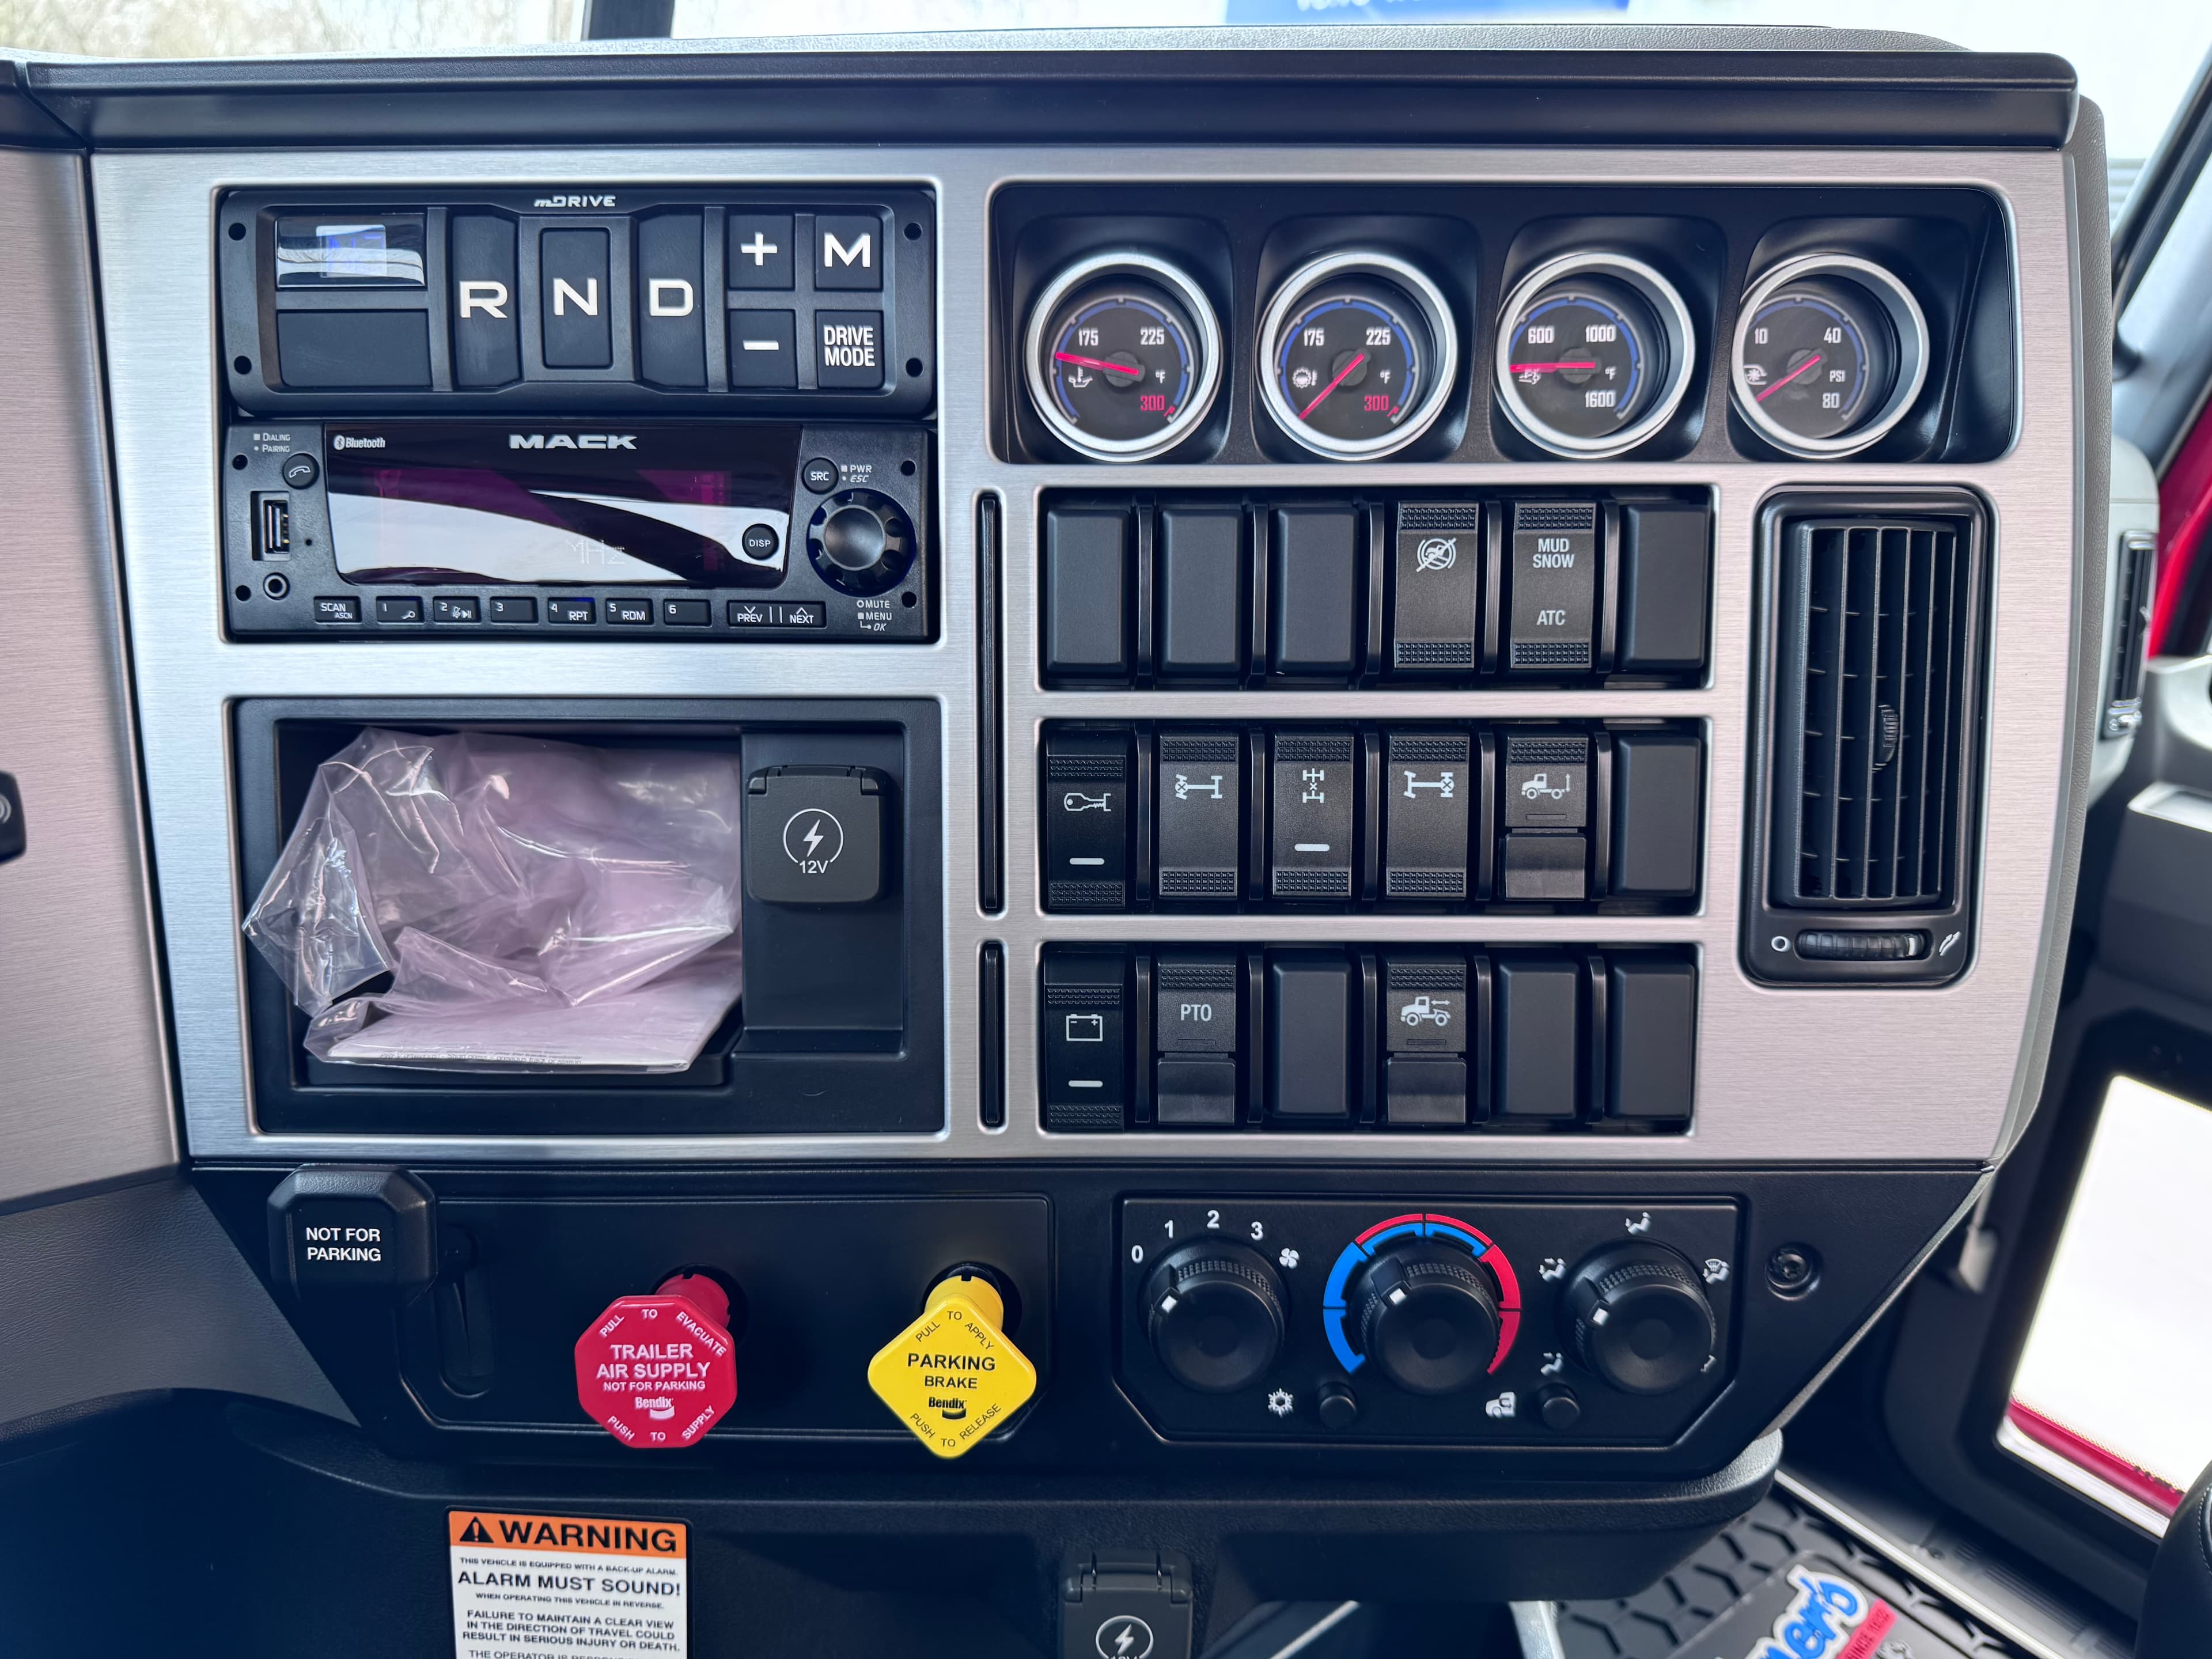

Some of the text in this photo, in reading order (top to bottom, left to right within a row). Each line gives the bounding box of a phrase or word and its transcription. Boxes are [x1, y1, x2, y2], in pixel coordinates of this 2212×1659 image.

[533, 195, 616, 207] mDRIVE
[824, 232, 871, 268] M
[459, 281, 507, 319] R
[552, 278, 598, 316] N
[649, 278, 693, 317] D
[824, 325, 873, 346] DRIVE
[1078, 328, 1099, 346] 175
[1140, 327, 1165, 346] 225
[1303, 328, 1324, 346] 175
[1366, 327, 1391, 346] 225
[1528, 327, 1555, 344] 600
[1585, 325, 1616, 342] 1000
[1755, 327, 1768, 344] 10
[1824, 327, 1842, 344] 40
[824, 347, 875, 367] MODE
[1829, 370, 1846, 382] PSI
[1140, 395, 1165, 411] 300
[1363, 395, 1389, 411] 300
[1585, 391, 1616, 408] 1600
[1822, 392, 1840, 408] 80
[345, 437, 386, 449] Bluetooth
[509, 434, 638, 449] MACK
[810, 471, 830, 481] SRC
[850, 464, 872, 473] PWR
[850, 475, 869, 483] ESC
[749, 539, 771, 548] DISP
[1537, 538, 1570, 552] MUD
[1532, 554, 1575, 569] SNOW
[320, 603, 346, 612] SCAN
[382, 603, 388, 612] 1
[440, 602, 448, 611] 2
[496, 603, 503, 612] 3
[550, 603, 558, 612] 4
[609, 603, 616, 612] 5
[668, 604, 677, 614] 6
[865, 600, 890, 608] MUTE
[567, 611, 589, 621] RPT
[621, 610, 646, 621] RDM
[737, 612, 763, 623] PREV
[789, 614, 814, 624] NEXT
[866, 612, 892, 620] MENU
[1536, 609, 1566, 626] ATC
[873, 623, 887, 631] OK
[799, 860, 828, 874] 12V
[1180, 1003, 1212, 1021] PTO
[1207, 1209, 1220, 1229] 2
[306, 1227, 381, 1241] NOT FOR
[1164, 1219, 1174, 1239] 1
[1251, 1221, 1263, 1241] 3
[307, 1247, 381, 1262] PARKING
[1131, 1245, 1144, 1264] 0
[599, 1309, 727, 1357] PULL TO EVACUATE
[915, 1310, 994, 1350] PULL TO APPLY
[610, 1343, 694, 1359] TRAILER
[596, 1362, 711, 1379] AIR SUPPLY
[907, 1353, 995, 1372] PARKING
[603, 1381, 706, 1391] NOT FOR PARKING
[925, 1375, 978, 1389] BRAKE
[635, 1396, 672, 1409] Bendix
[928, 1396, 965, 1409] Bendix
[608, 1405, 715, 1442] PUSH TO SUPPLY
[910, 1403, 1001, 1448] PUSH TO RELEASE
[499, 1520, 677, 1552] WARNING
[481, 1558, 517, 1566] VEHICLE
[529, 1560, 572, 1570] EQUIPPED
[574, 1563, 595, 1571] WITH
[605, 1565, 644, 1574] BACK-UP
[646, 1567, 678, 1575] ALARM.
[458, 1570, 681, 1596] ALARM MUST SOUND!
[503, 1593, 552, 1603] OPERATING
[554, 1596, 573, 1604] THIS
[575, 1598, 611, 1606] VEHICLE
[467, 1609, 675, 1629] FAILURE TO MAINTAIN A CLEAR VIEW
[467, 1620, 675, 1640] IN THE DIRECTION OF TRAVEL COULD
[463, 1631, 680, 1652] RESULT IN SERIOUS INJURY OR DEATH.
[468, 1649, 491, 1659] THE
[493, 1650, 556, 1659] OPERATOR
